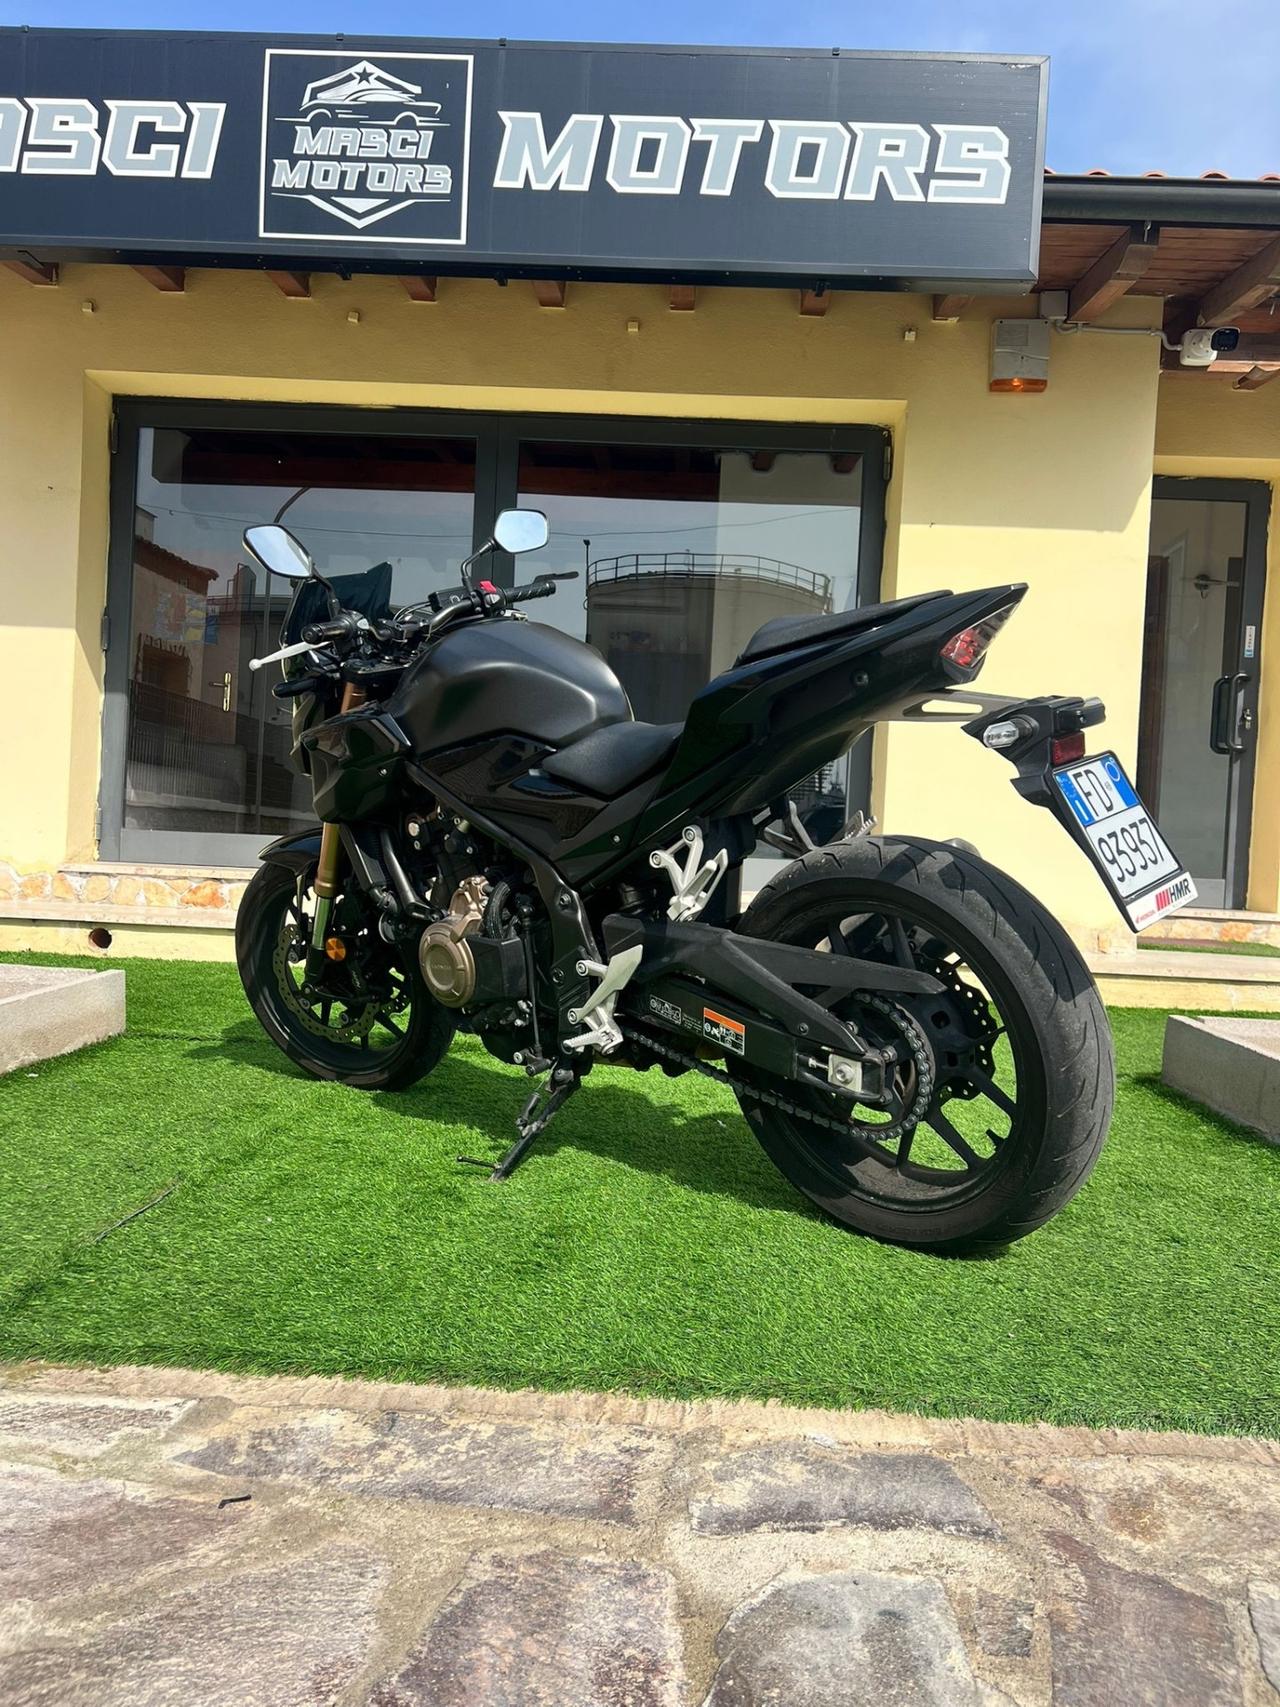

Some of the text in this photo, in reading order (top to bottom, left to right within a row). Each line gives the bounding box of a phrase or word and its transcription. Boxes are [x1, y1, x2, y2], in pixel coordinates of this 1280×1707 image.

[293, 126, 434, 159] MASCI
[493, 110, 1012, 204] MOTORS
[271, 159, 452, 194] MOTORS
[1072, 769, 1114, 817] FD
[1098, 817, 1164, 883] 93937
[1169, 878, 1191, 904] HMR
